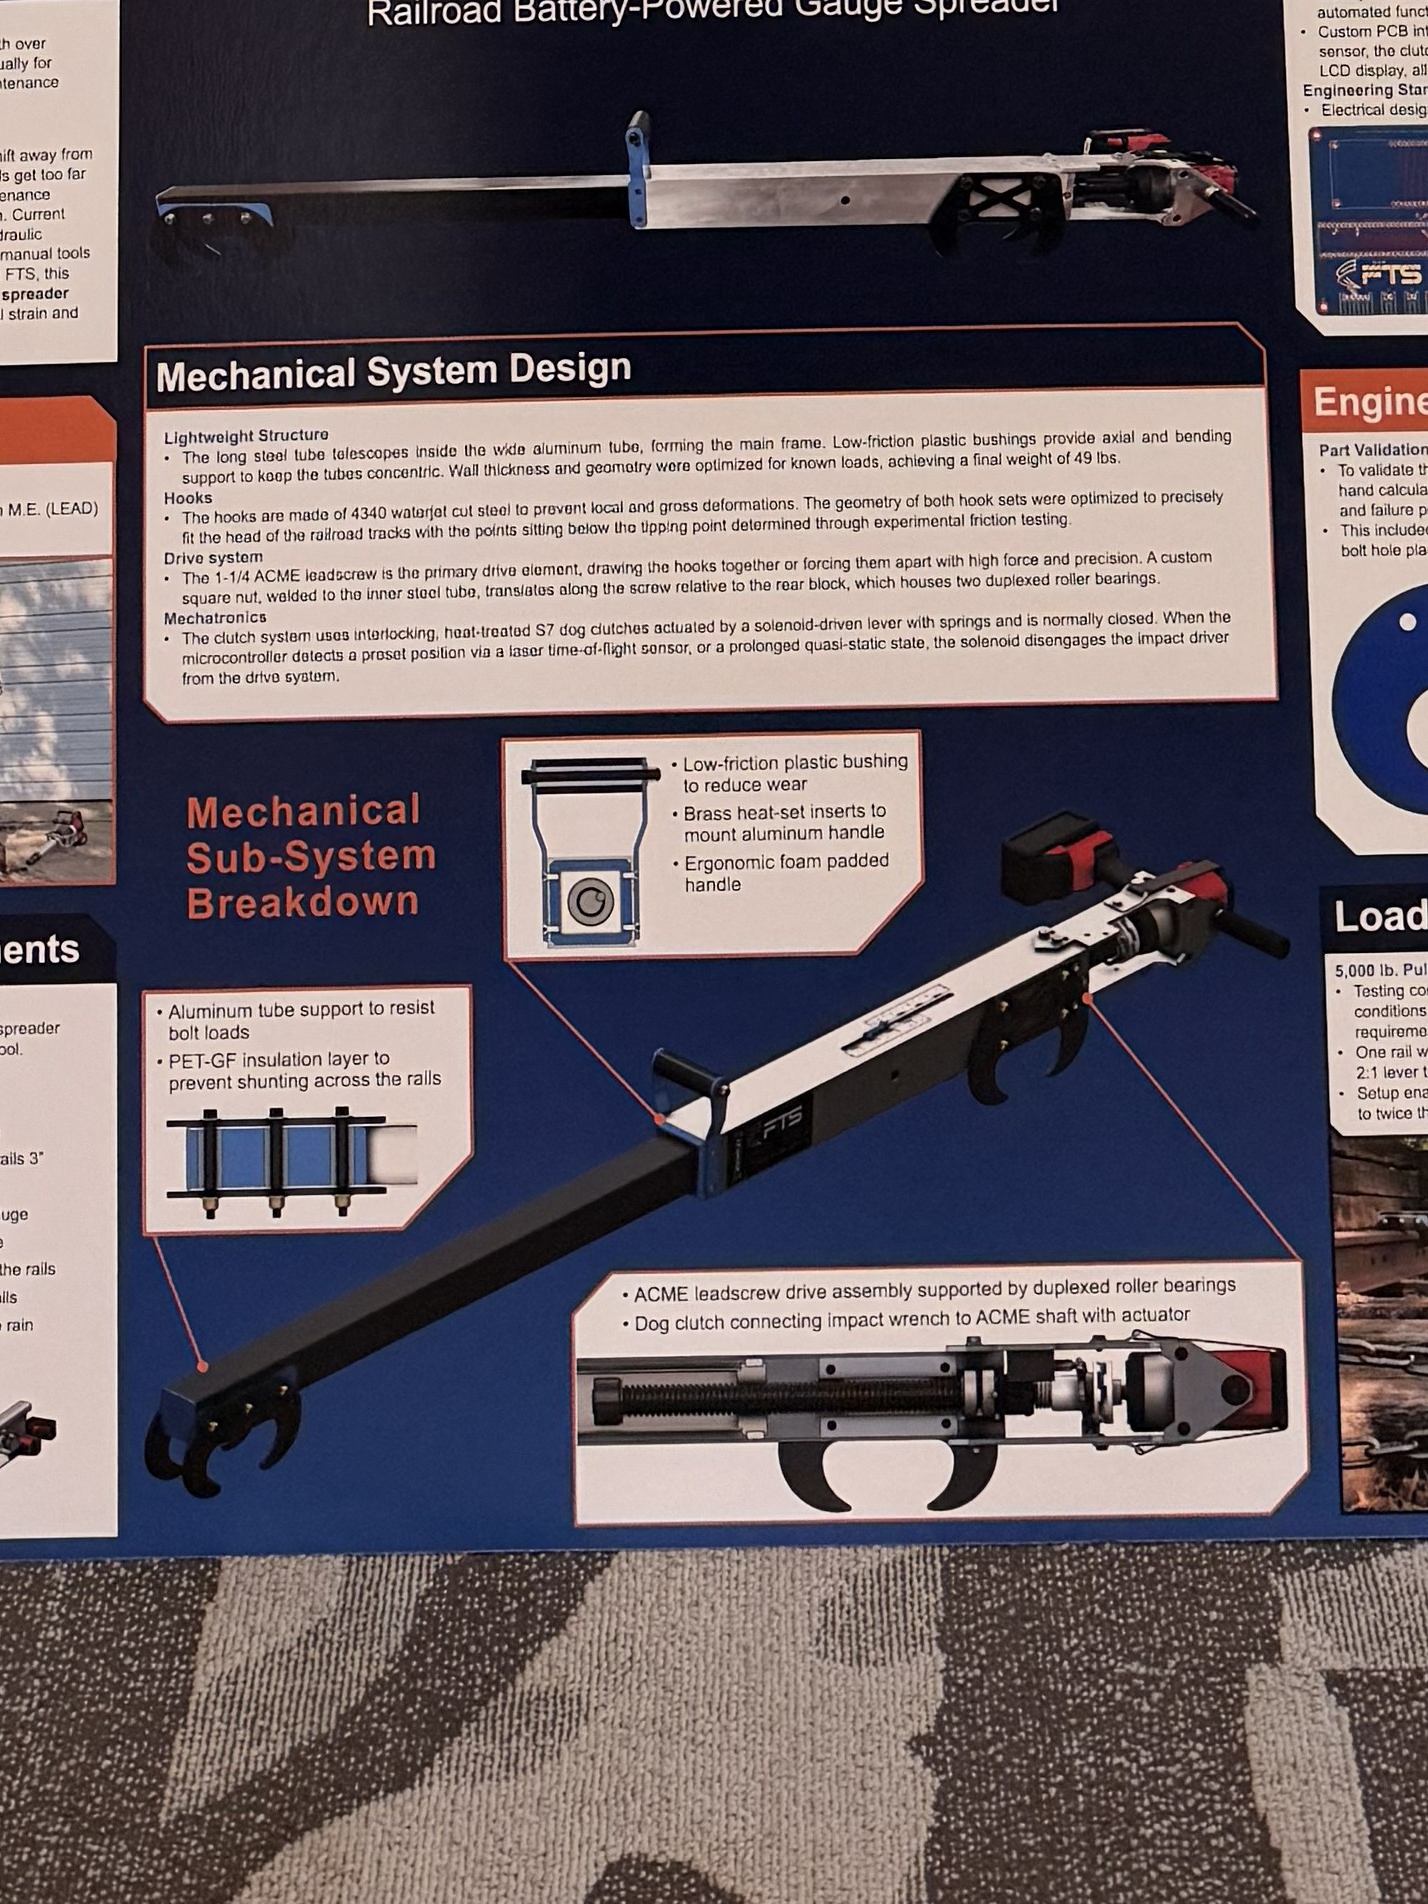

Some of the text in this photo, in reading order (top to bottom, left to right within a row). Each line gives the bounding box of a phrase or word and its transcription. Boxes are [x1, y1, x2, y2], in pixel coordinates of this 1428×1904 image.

[15, 39, 46, 50] over
[1303, 83, 1393, 100] Engineering
[1361, 262, 1422, 286] FTS
[157, 351, 631, 393] Mechanical System Design
[164, 428, 328, 447] Lightweight Structure
[1319, 443, 1350, 457] Part
[1354, 442, 1428, 456] Validation
[164, 491, 212, 505] Hooks
[164, 551, 263, 567] Drive system
[164, 610, 267, 625] Mechatronics
[684, 752, 908, 773] Low-friction plastic bushing
[684, 777, 808, 793] to reduce wear
[188, 791, 419, 829] Mechanical
[187, 839, 435, 880] Sub-System
[188, 884, 418, 919] Breakdown
[1335, 898, 1428, 932] Load
[1335, 963, 1374, 979] 5,000
[1379, 963, 1398, 976] lb.
[763, 1105, 803, 1139] FTS
[634, 1277, 1236, 1303] ACME leadscrew drive assembly supported by duplexed roller bearings
